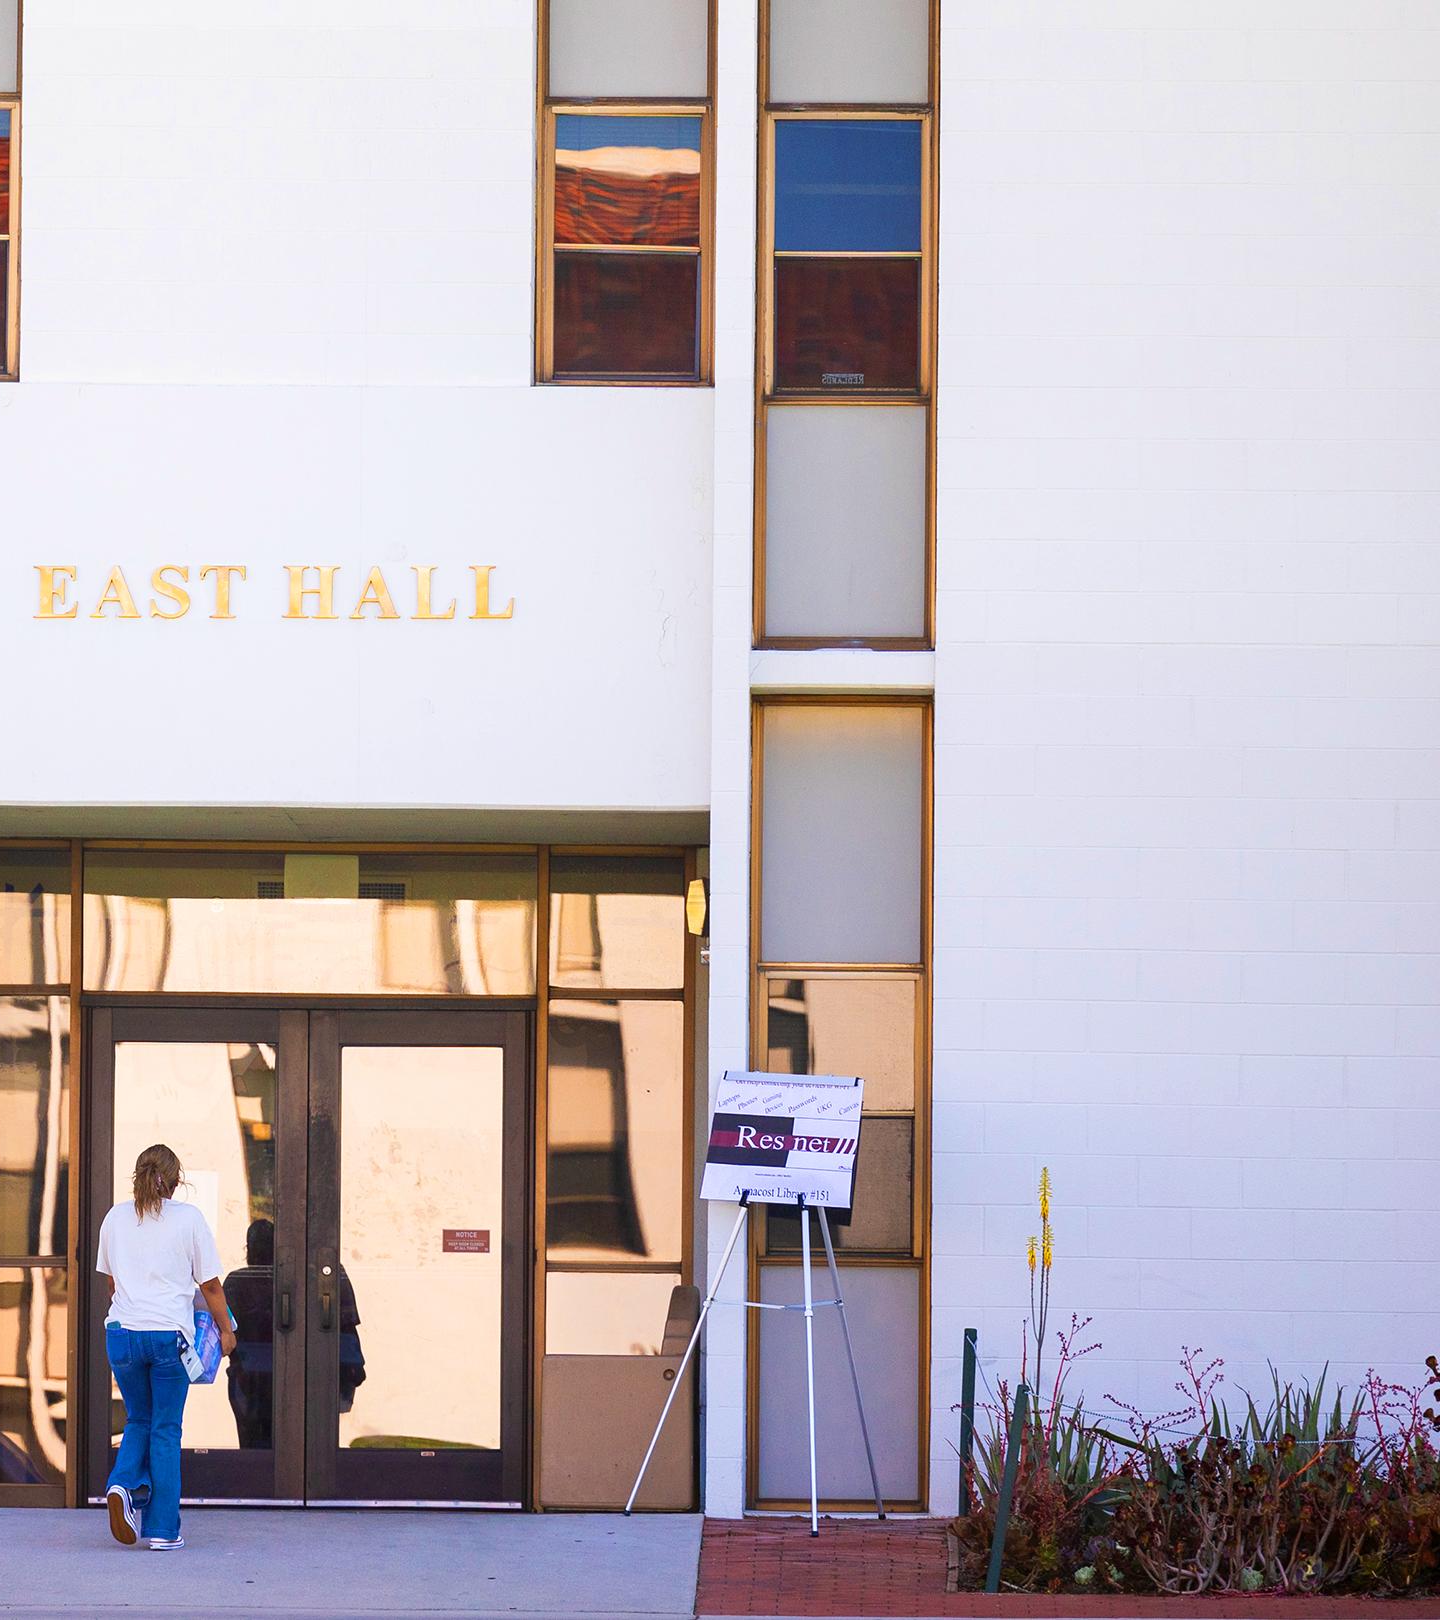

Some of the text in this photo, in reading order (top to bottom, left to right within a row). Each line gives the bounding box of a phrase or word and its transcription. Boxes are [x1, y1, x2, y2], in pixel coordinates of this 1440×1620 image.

[33, 565, 515, 619] EAST HALL
[816, 1101, 833, 1114] UKG
[734, 1125, 831, 1153] Res net
[810, 1189, 829, 1201] #151
